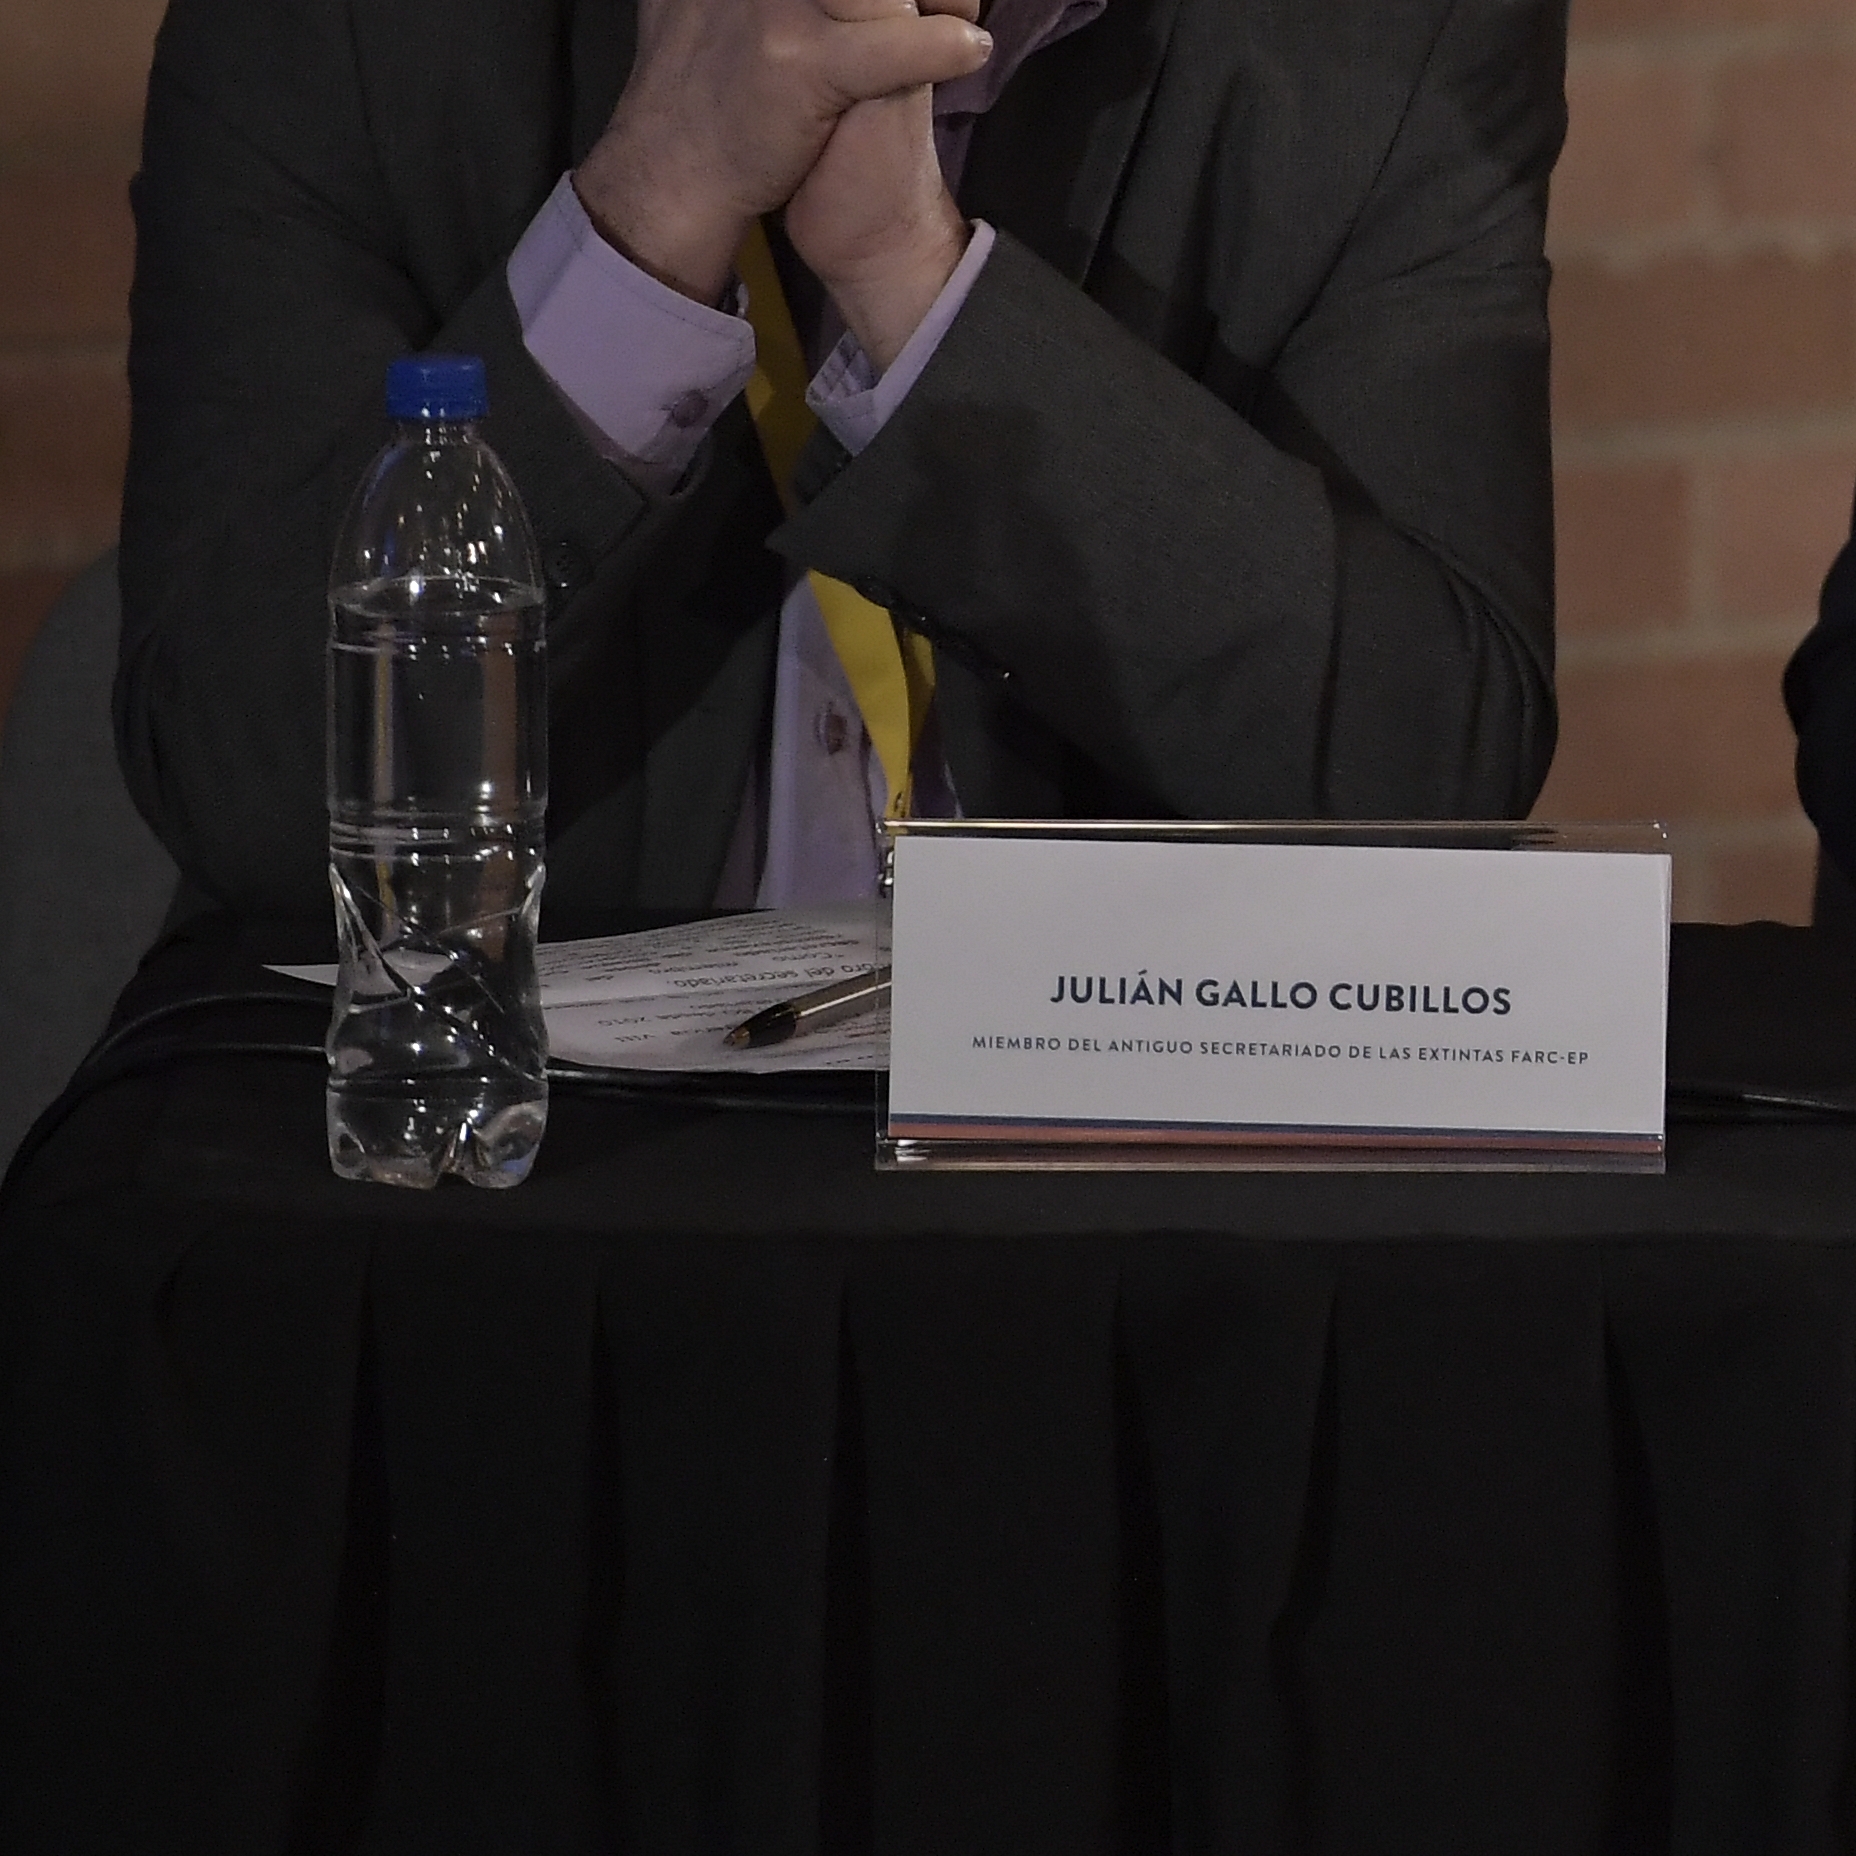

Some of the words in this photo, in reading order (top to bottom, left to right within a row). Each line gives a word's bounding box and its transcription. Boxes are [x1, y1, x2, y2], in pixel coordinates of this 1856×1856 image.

[666, 970, 799, 988] secretariado.
[805, 966, 835, 978] del
[1048, 967, 1183, 1007] JULIÁN
[1194, 977, 1318, 1010] GALLO
[1327, 981, 1511, 1016] CUBILLOS
[971, 1034, 1061, 1051] MIEMBRO
[1066, 1036, 1102, 1053] DEL
[1106, 1038, 1193, 1055] ANTIGUO
[1198, 1040, 1342, 1059] SECRETARIADO
[1347, 1044, 1372, 1060] DE
[1378, 1045, 1411, 1061] LAS
[1417, 1046, 1504, 1063] EXTINTAS
[1510, 1048, 1589, 1065] FARC-EP
